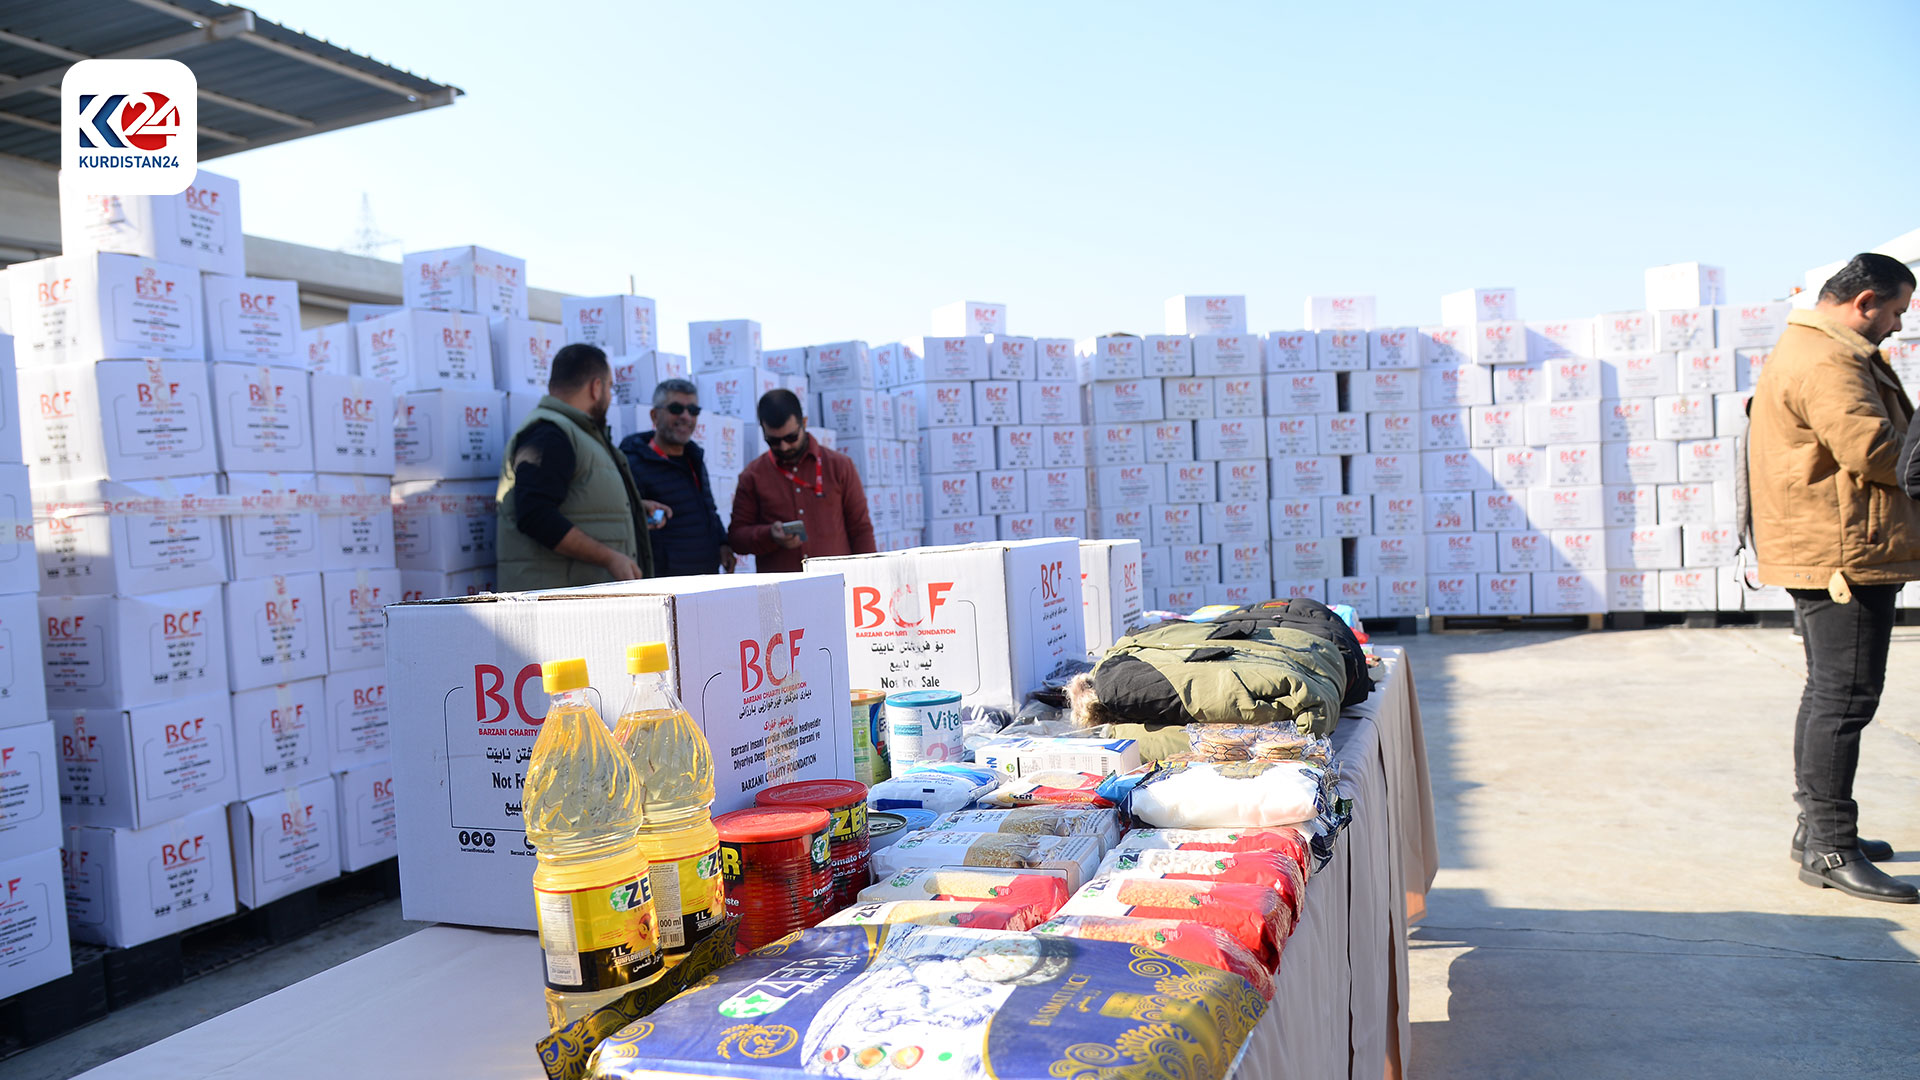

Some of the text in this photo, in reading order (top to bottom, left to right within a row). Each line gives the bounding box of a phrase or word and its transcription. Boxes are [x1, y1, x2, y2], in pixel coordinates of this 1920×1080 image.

[184, 185, 221, 208] BCF
[39, 278, 71, 303] BCF
[240, 292, 277, 312] BCF
[40, 390, 71, 416] BCF
[342, 397, 373, 417] BCF
[1041, 561, 1063, 600] BCF
[48, 616, 85, 638] BCF
[164, 613, 202, 637] BCF
[917, 628, 956, 636] OUNDATION
[739, 628, 805, 693] BCF
[921, 676, 940, 687] Sale
[353, 685, 385, 706] BCF
[474, 663, 547, 726] BC
[743, 694, 763, 705] BARZANI
[165, 718, 204, 744] BCF
[478, 728, 538, 737] BARZANI CHARITY
[374, 779, 394, 797] BC
[492, 772, 526, 789] Not Fo
[741, 774, 765, 792] BARZANI
[834, 801, 867, 837] ZER
[162, 835, 205, 866] BCF
[831, 854, 858, 867] omato
[625, 876, 651, 909] ZE
[658, 918, 673, 928] 000
